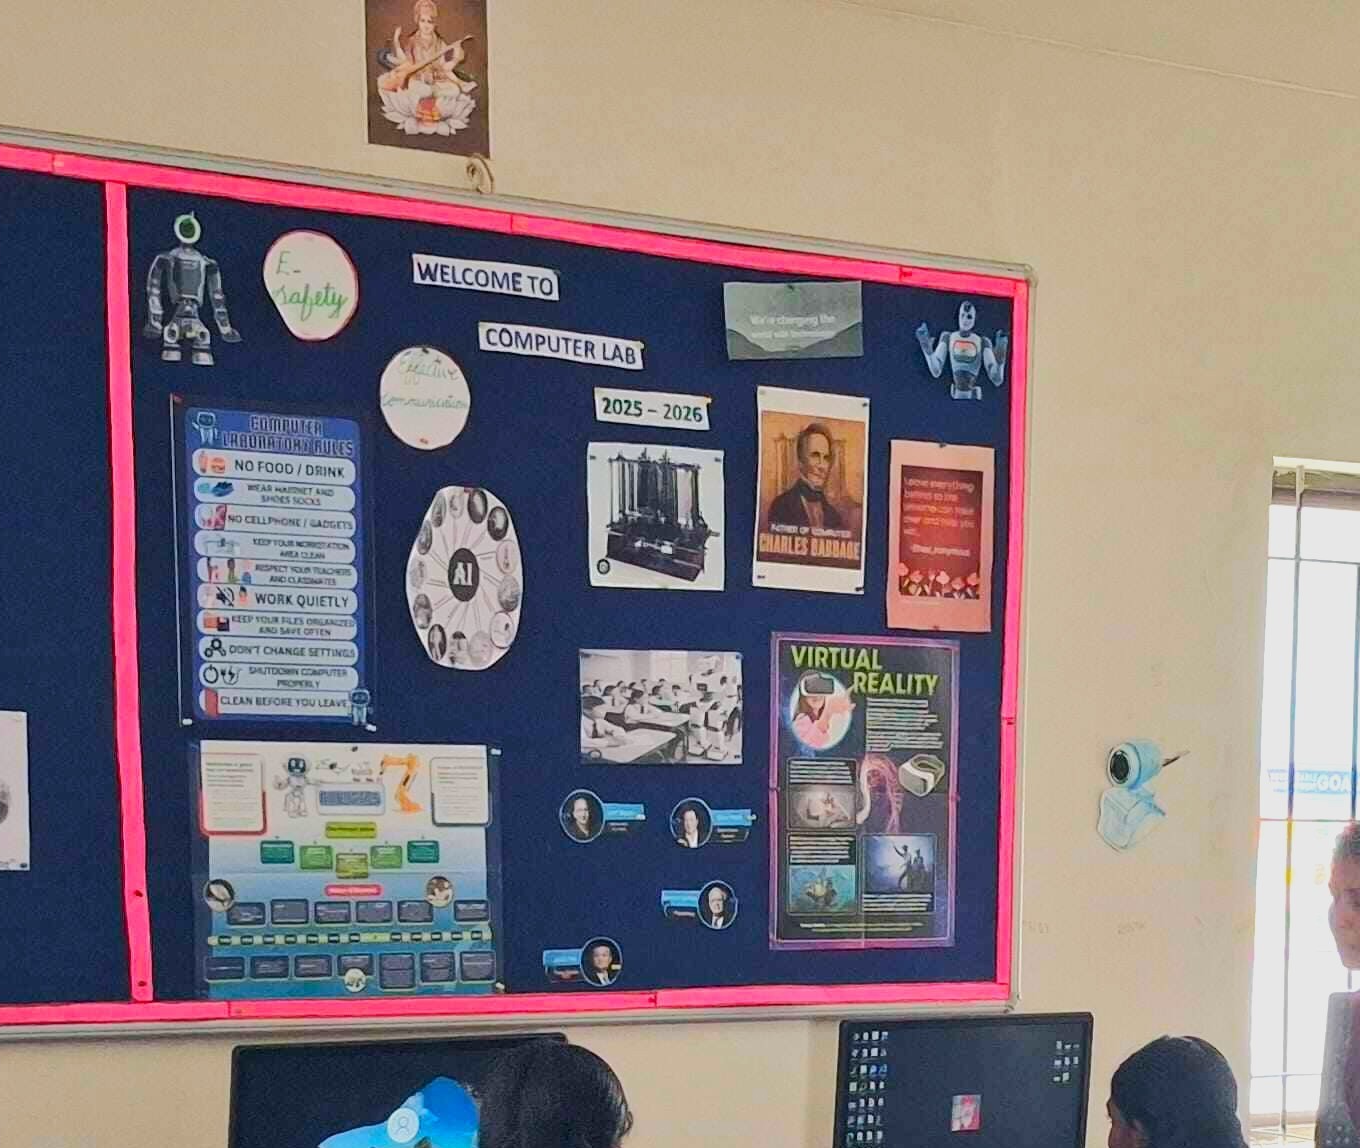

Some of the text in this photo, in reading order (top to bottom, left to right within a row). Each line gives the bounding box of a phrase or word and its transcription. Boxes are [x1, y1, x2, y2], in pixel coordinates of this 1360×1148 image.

[417, 262, 553, 296] WELCOME TO
[486, 328, 636, 366] COMPUTER LAB
[603, 397, 643, 418] 2025
[663, 404, 702, 423] 2026
[250, 414, 324, 436] COMPUTER
[312, 439, 353, 456] RULES
[234, 460, 254, 472] NO
[258, 461, 294, 475] FOOD
[306, 464, 345, 479] DRINK
[228, 514, 241, 523] NO
[245, 516, 301, 528] CELLPHONE
[310, 519, 353, 530] GADGETS
[760, 533, 809, 555] CHARLES
[453, 562, 472, 585] AI
[256, 593, 349, 608] WORK QUIETLY
[232, 615, 253, 624] KEEP
[229, 645, 355, 657] DON'T CHANGE SETTINGS
[791, 645, 882, 670] VIRTUAL
[301, 668, 348, 677] COMPUTER
[853, 672, 939, 696] REALITY
[220, 696, 348, 708] CLEAN BEFORE YOU LEAVE
